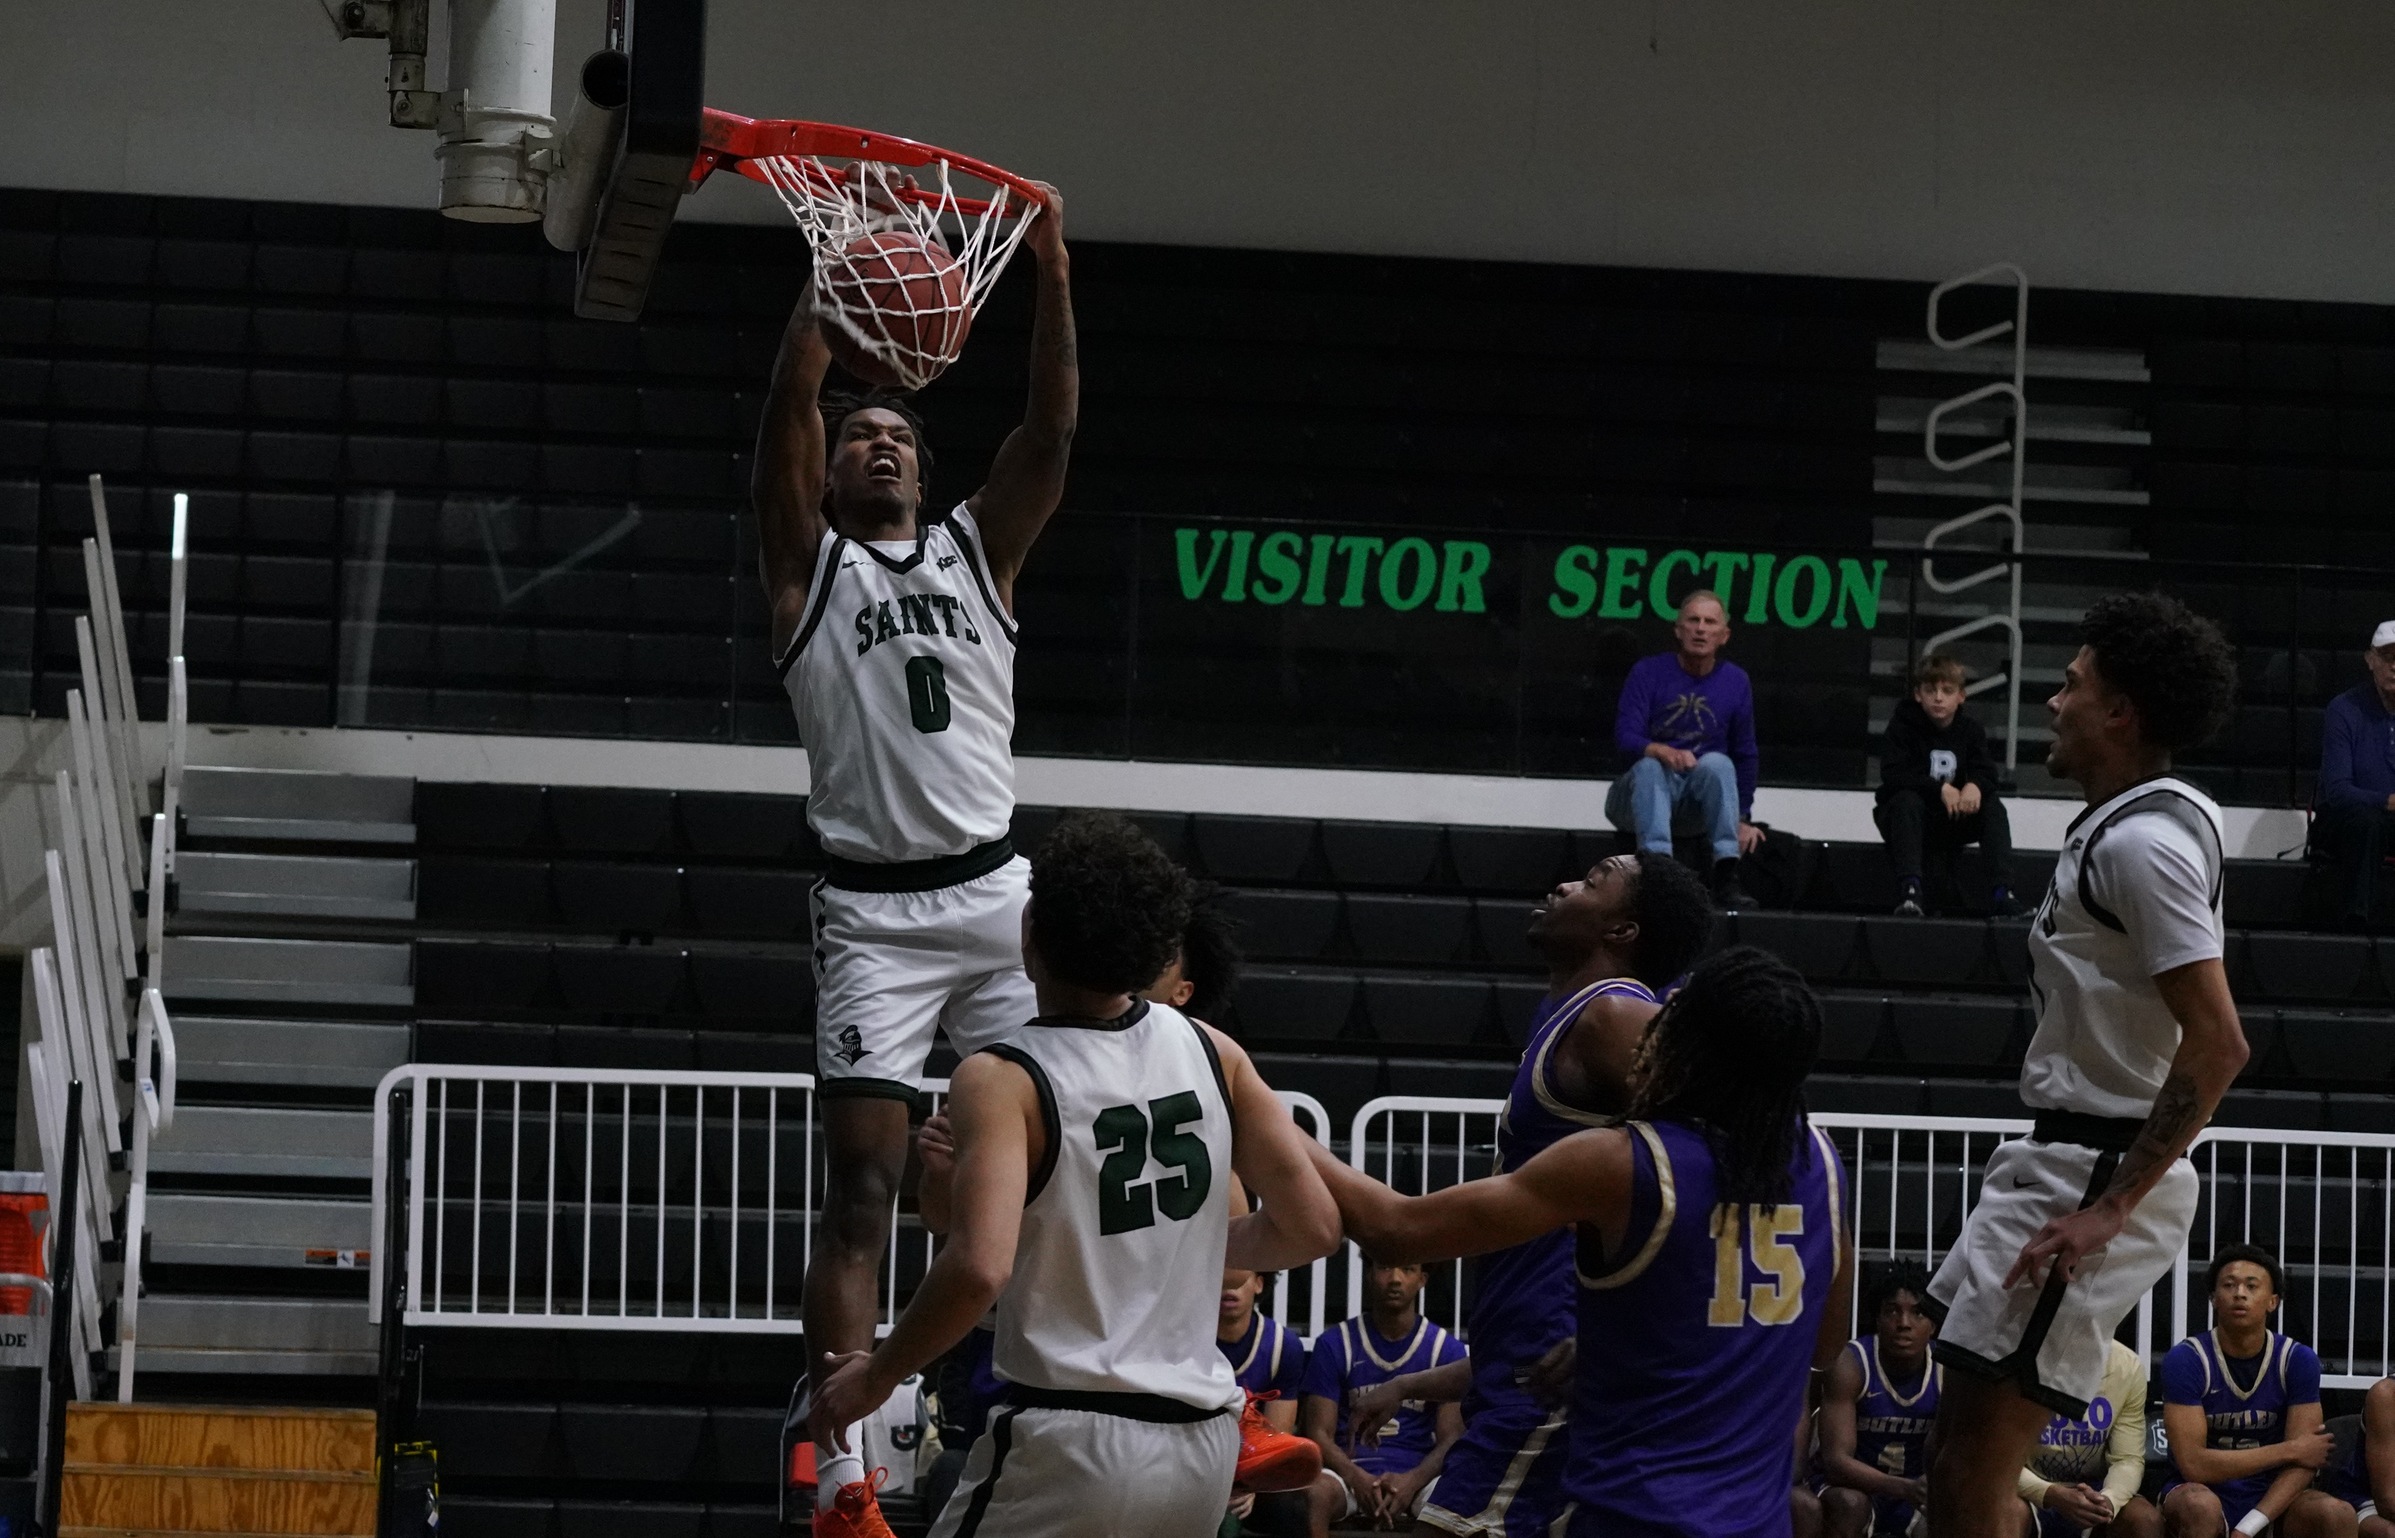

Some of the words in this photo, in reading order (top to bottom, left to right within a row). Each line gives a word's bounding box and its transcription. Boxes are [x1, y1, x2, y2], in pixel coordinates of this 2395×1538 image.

[1174, 528, 1492, 613] VISITOR
[1548, 545, 1888, 630] SECTION
[855, 593, 981, 657] SAINTS
[905, 656, 951, 733] 0
[1092, 1090, 1212, 1236] 25
[1707, 1202, 1806, 1328] 15
[1857, 1416, 1931, 1434] BUTLE
